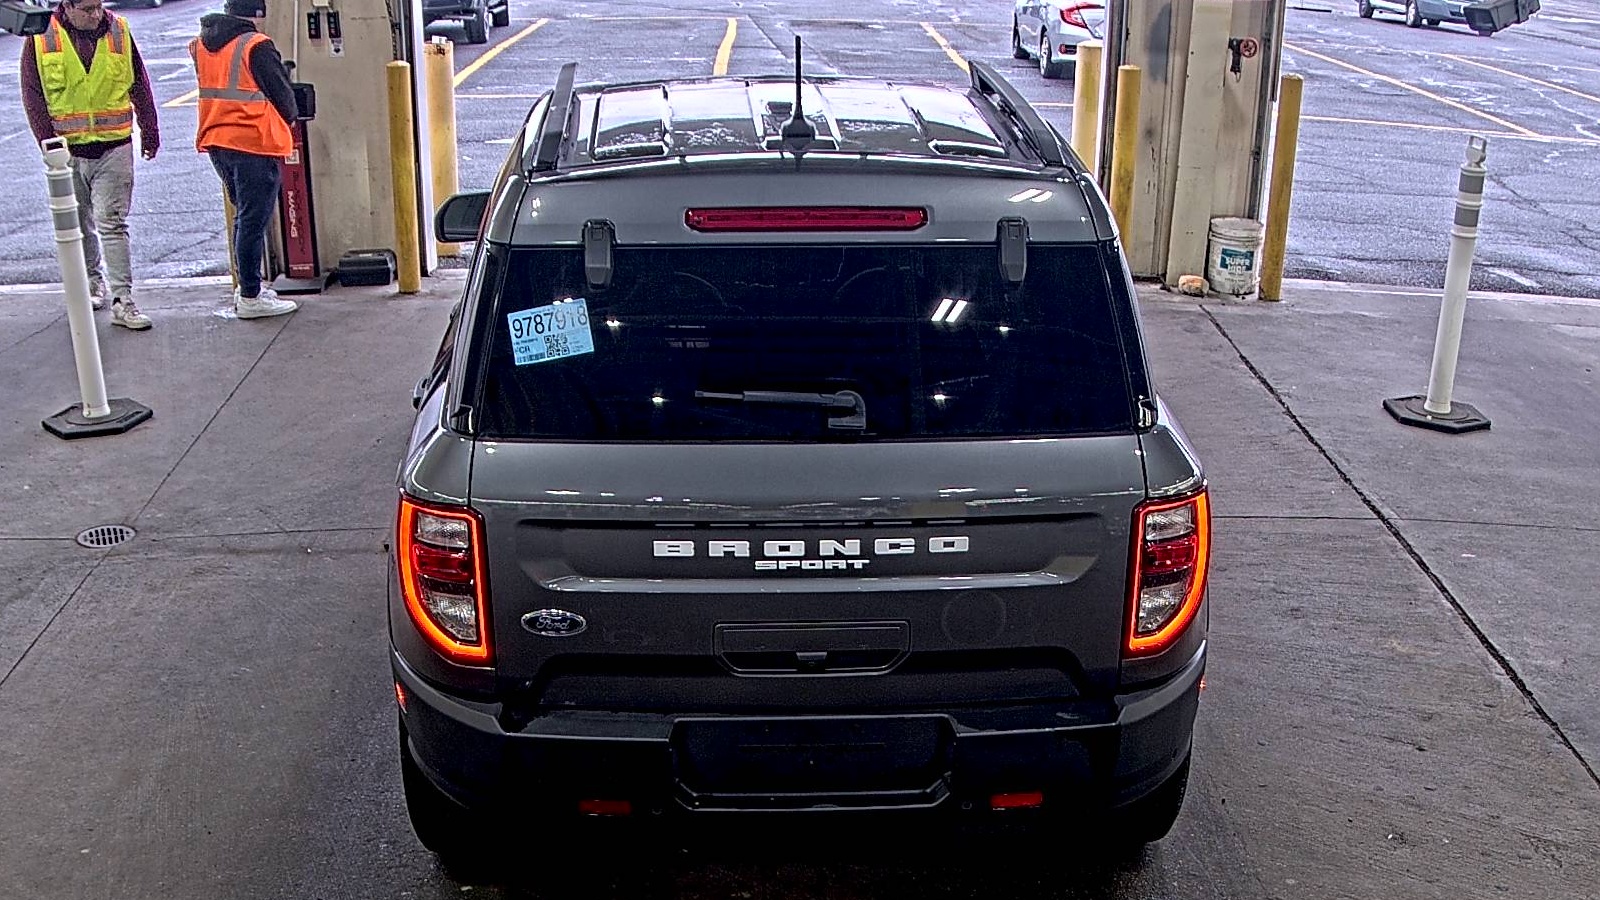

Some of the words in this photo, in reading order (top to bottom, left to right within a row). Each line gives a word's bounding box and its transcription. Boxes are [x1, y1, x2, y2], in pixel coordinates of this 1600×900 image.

[1225, 256, 1250, 266] SUPER
[512, 305, 588, 339] 9787918
[653, 536, 969, 557] BRONCO
[755, 559, 870, 570] SPORT
[536, 616, 571, 629] Ford
